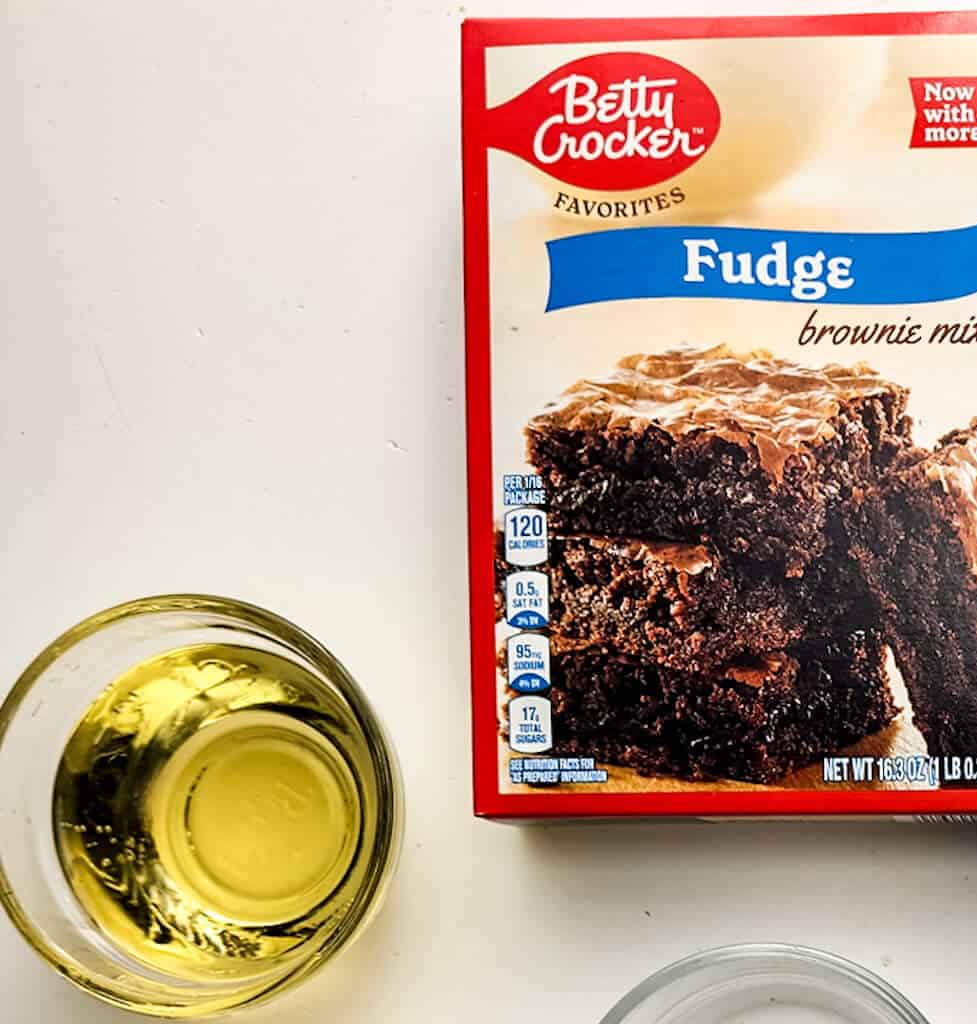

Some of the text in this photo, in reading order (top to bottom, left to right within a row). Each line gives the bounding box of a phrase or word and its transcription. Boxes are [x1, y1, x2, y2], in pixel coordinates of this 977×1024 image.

[549, 74, 677, 128] Betty
[924, 82, 975, 101] Now
[924, 103, 974, 123] with
[533, 114, 705, 165] Crocker
[552, 186, 687, 219] FAVORITES
[682, 238, 855, 300] Fudge
[798, 309, 922, 347] brownie
[504, 475, 523, 489] PER
[504, 490, 546, 505] PACKAGE
[510, 515, 543, 537] 120
[512, 599, 543, 609] SAT FAT
[515, 734, 547, 744] SUGARS
[823, 757, 850, 781] NET
[852, 757, 874, 781] WT
[877, 757, 904, 781] 16.3
[907, 756, 926, 781] OZ
[928, 756, 940, 786] (1
[944, 756, 962, 780] LB
